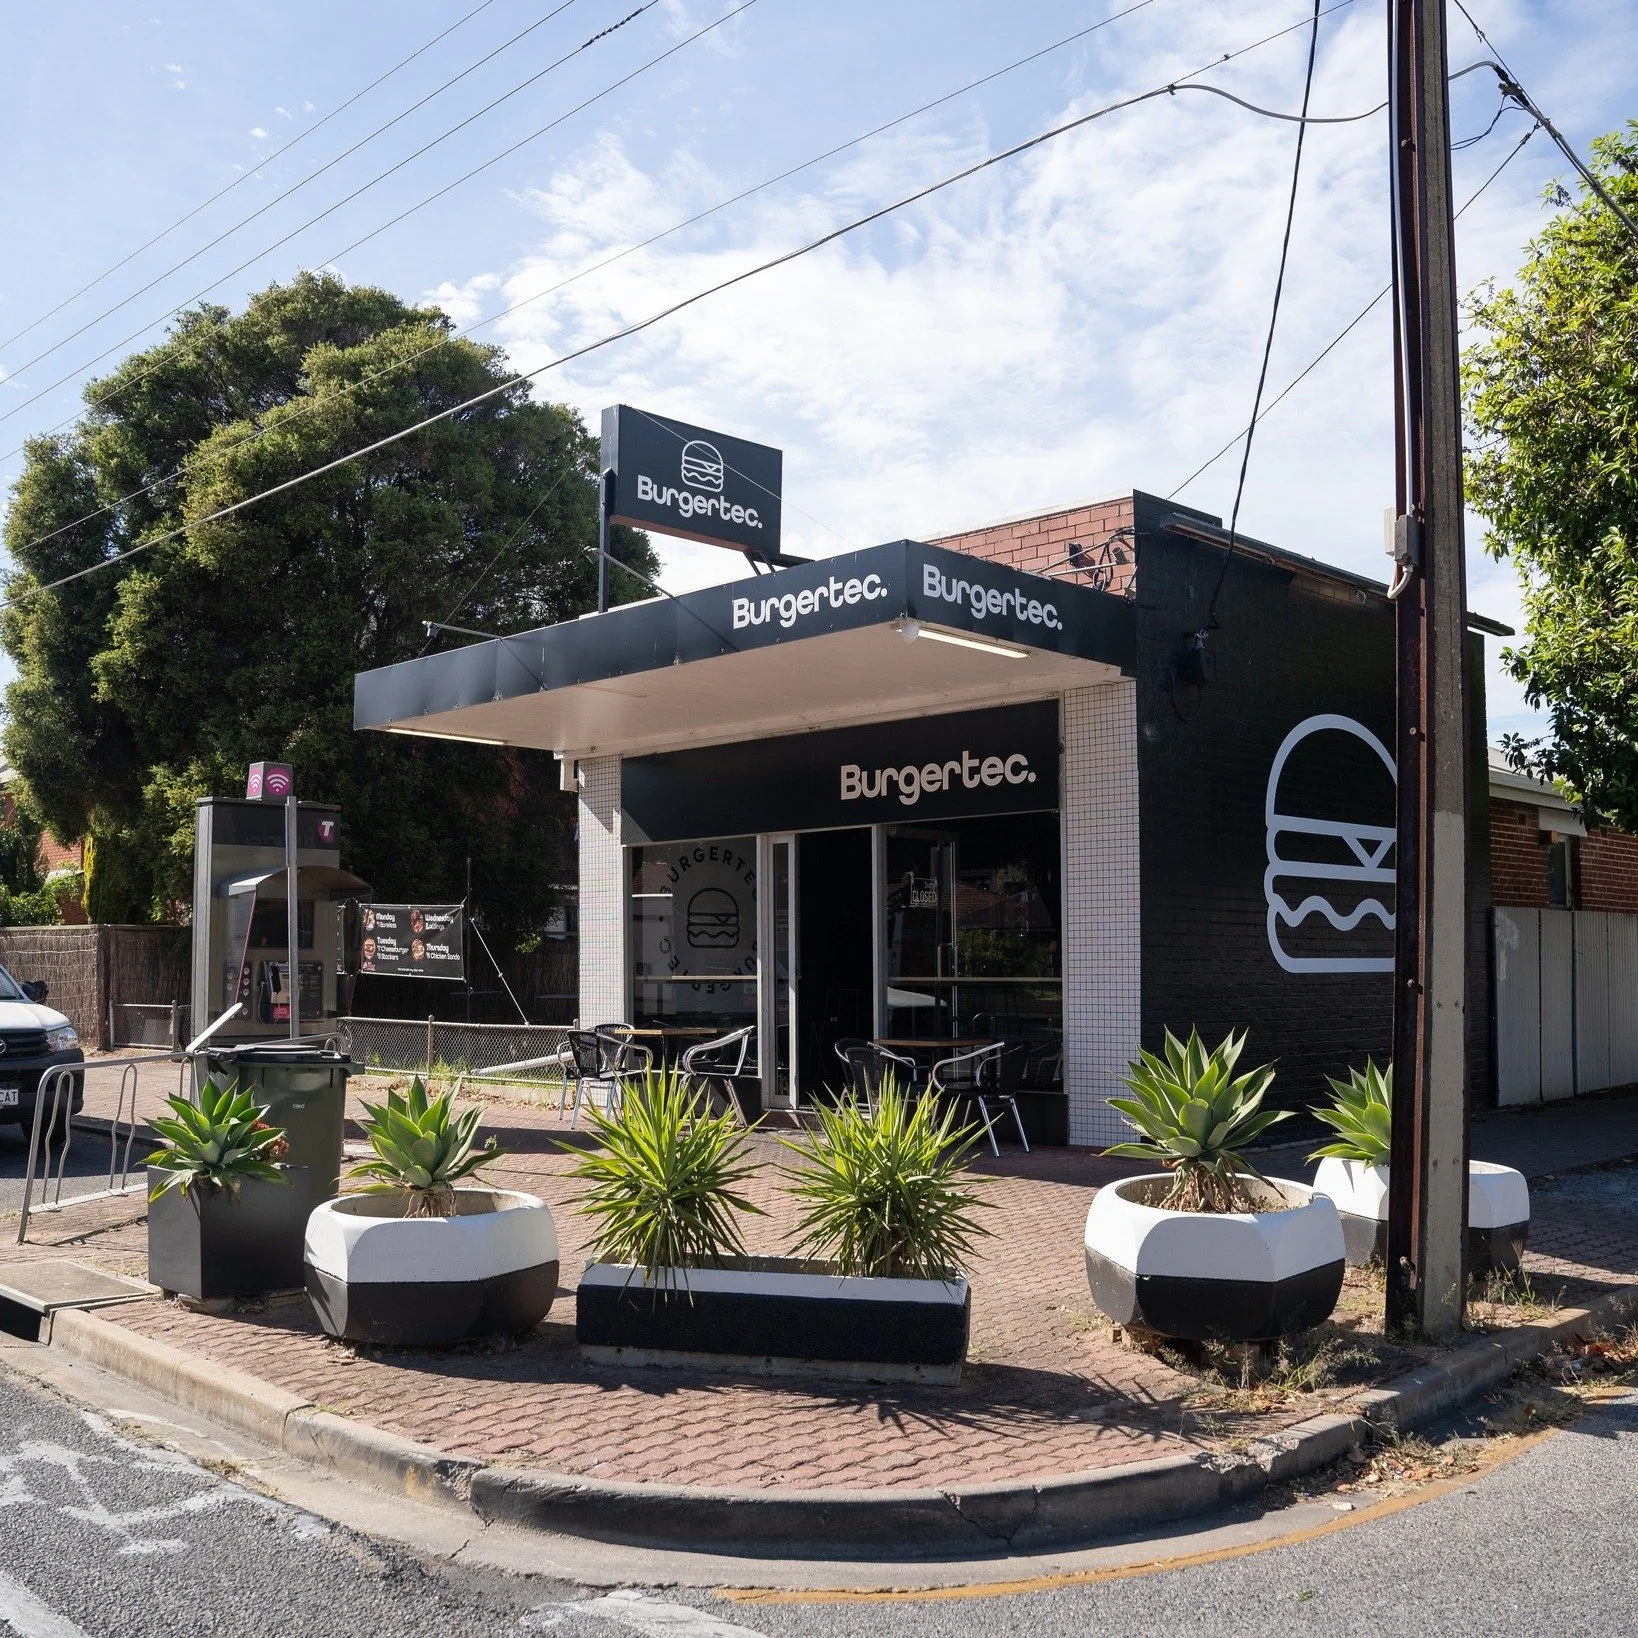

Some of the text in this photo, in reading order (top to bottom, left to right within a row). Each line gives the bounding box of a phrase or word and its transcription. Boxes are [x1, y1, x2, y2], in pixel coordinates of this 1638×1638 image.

[636, 475, 763, 530] Burgertec.
[731, 574, 888, 630] Burgertec.
[922, 563, 1063, 631] Burgertec.
[840, 750, 1036, 806] Burgertec.
[375, 913, 395, 922] Monday
[424, 914, 454, 924] Wednesday
[377, 936, 396, 946] Tuesday
[381, 945, 409, 955] Cheeseburger
[426, 943, 449, 953] Thursday
